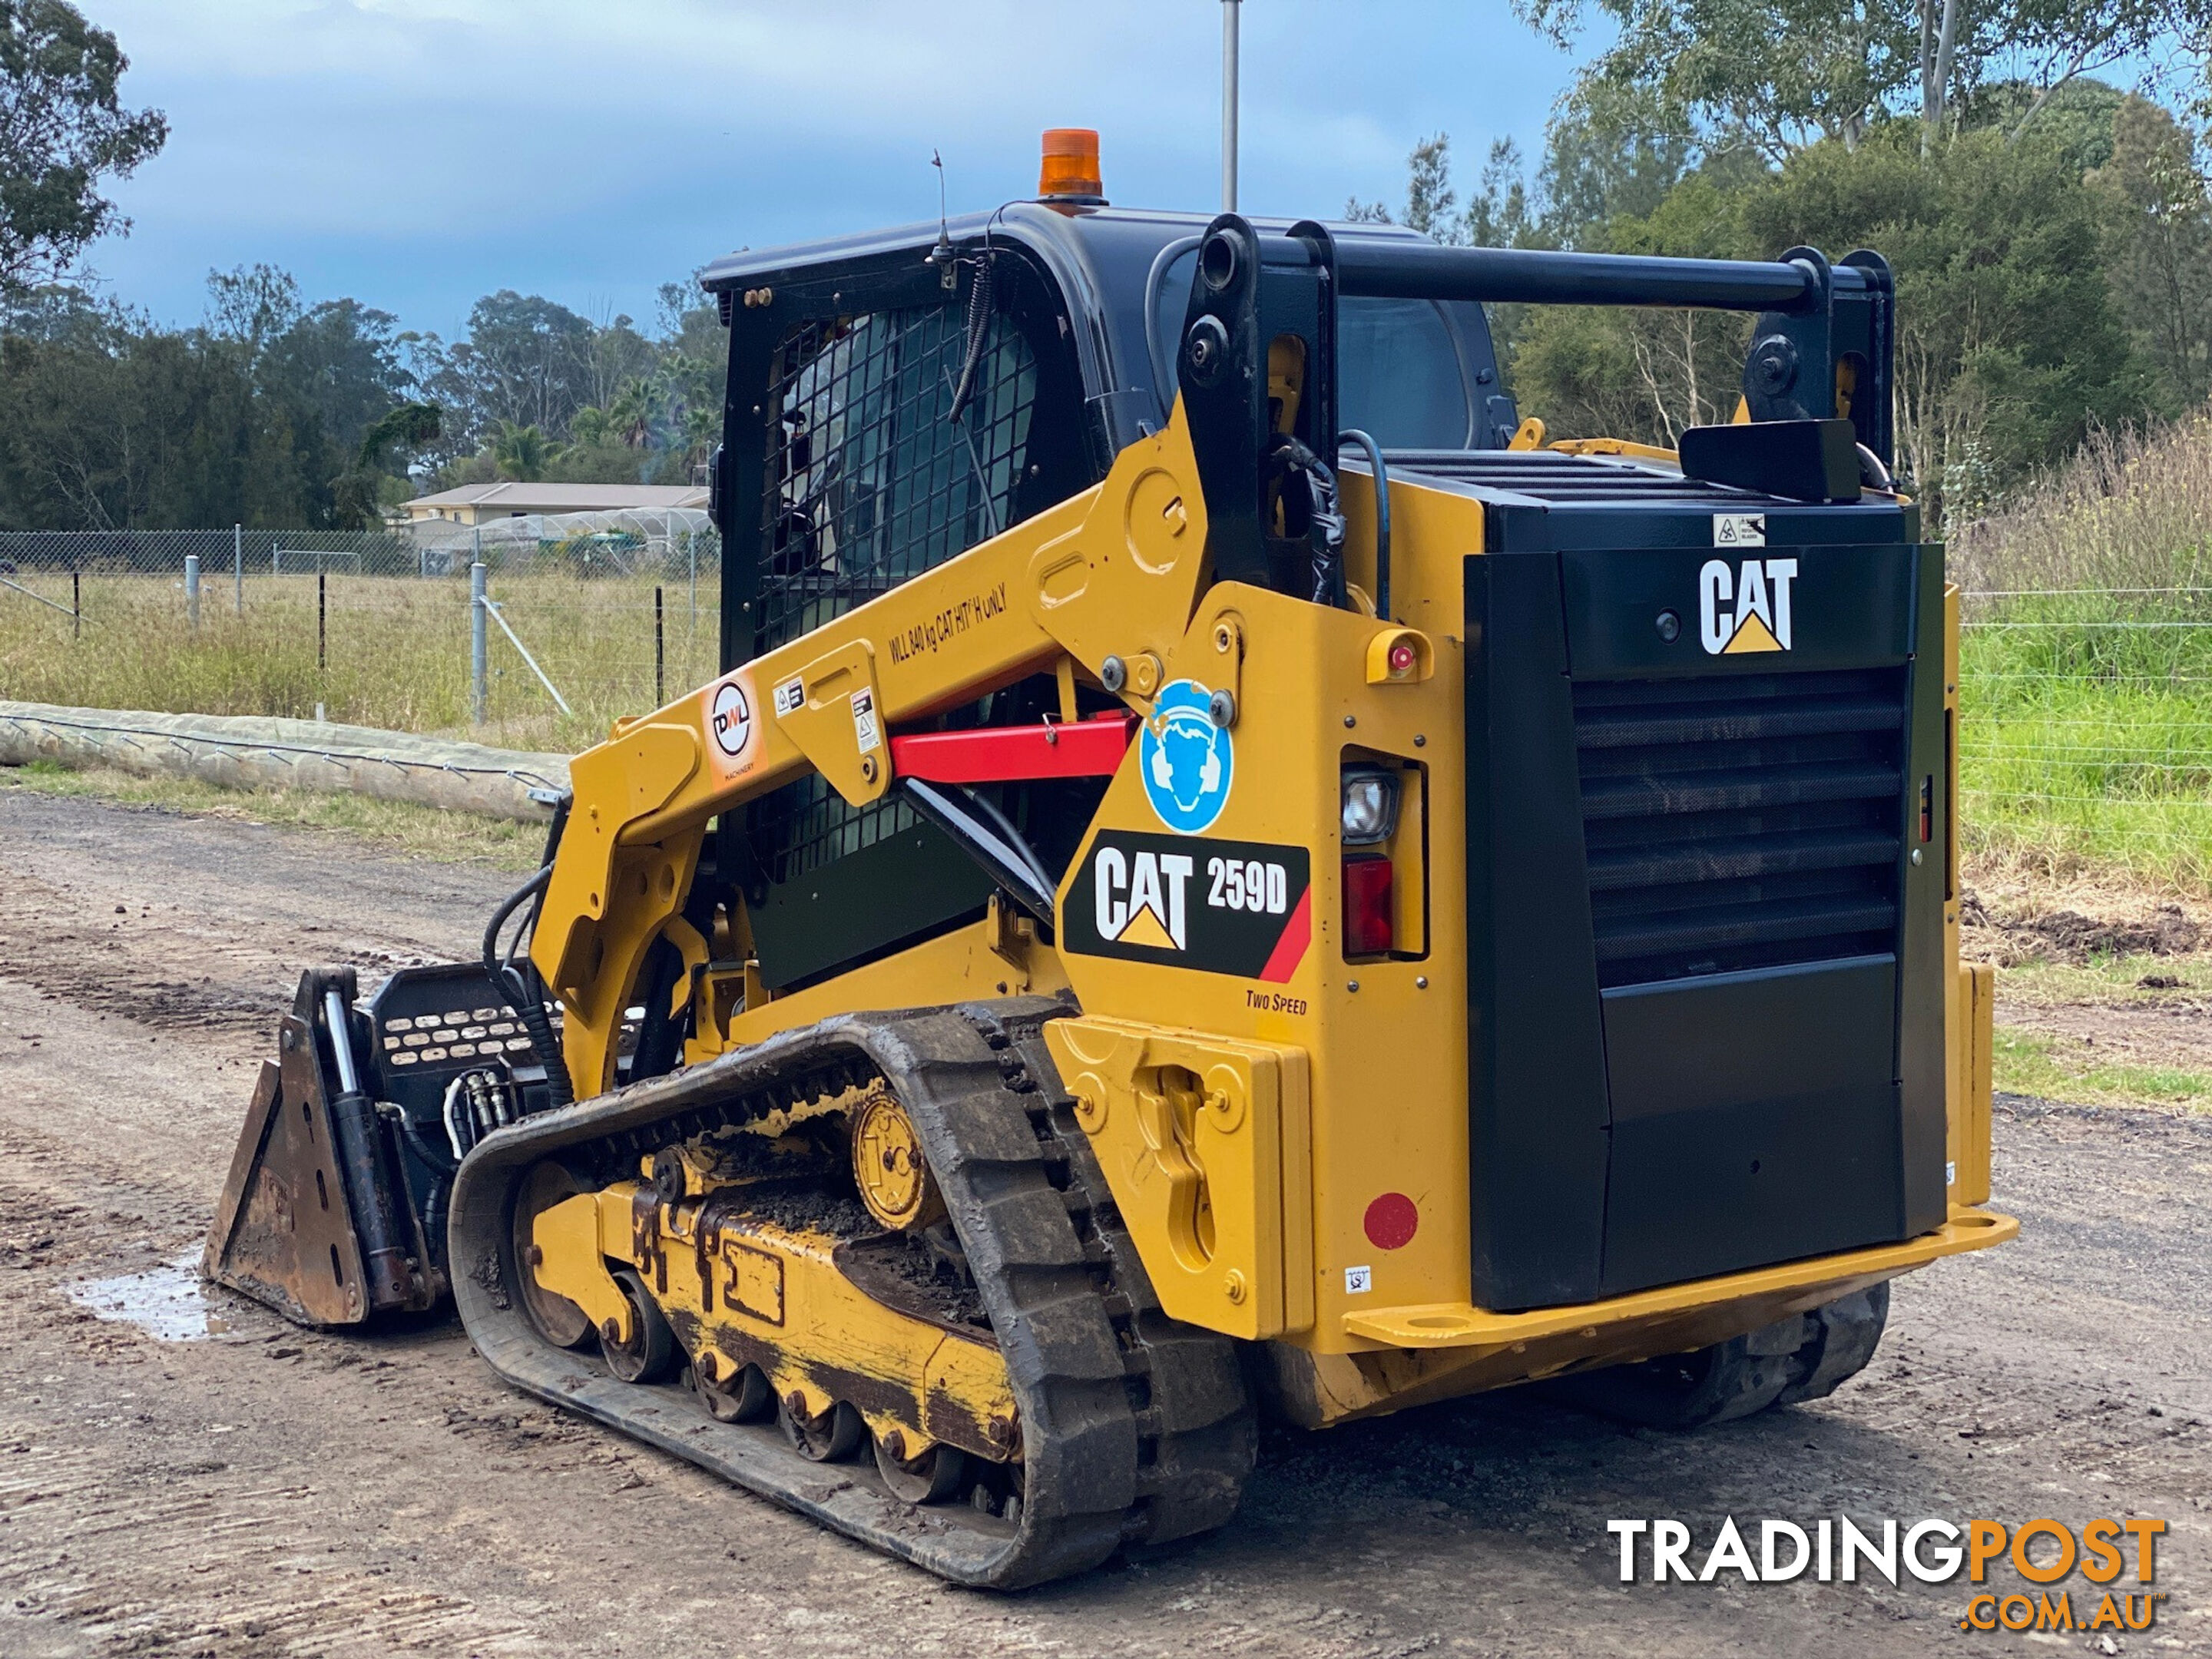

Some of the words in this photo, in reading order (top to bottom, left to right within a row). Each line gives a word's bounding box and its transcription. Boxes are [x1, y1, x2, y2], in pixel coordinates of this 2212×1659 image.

[1700, 558, 1798, 655] CAT
[889, 634, 910, 665] WLL
[909, 624, 925, 656] 840
[923, 621, 938, 653] kg
[935, 609, 955, 642] CAT
[713, 704, 750, 735] DWL
[725, 762, 755, 782] MACHINERY
[1094, 846, 1194, 951] CAT
[1207, 856, 1287, 915] 259D
